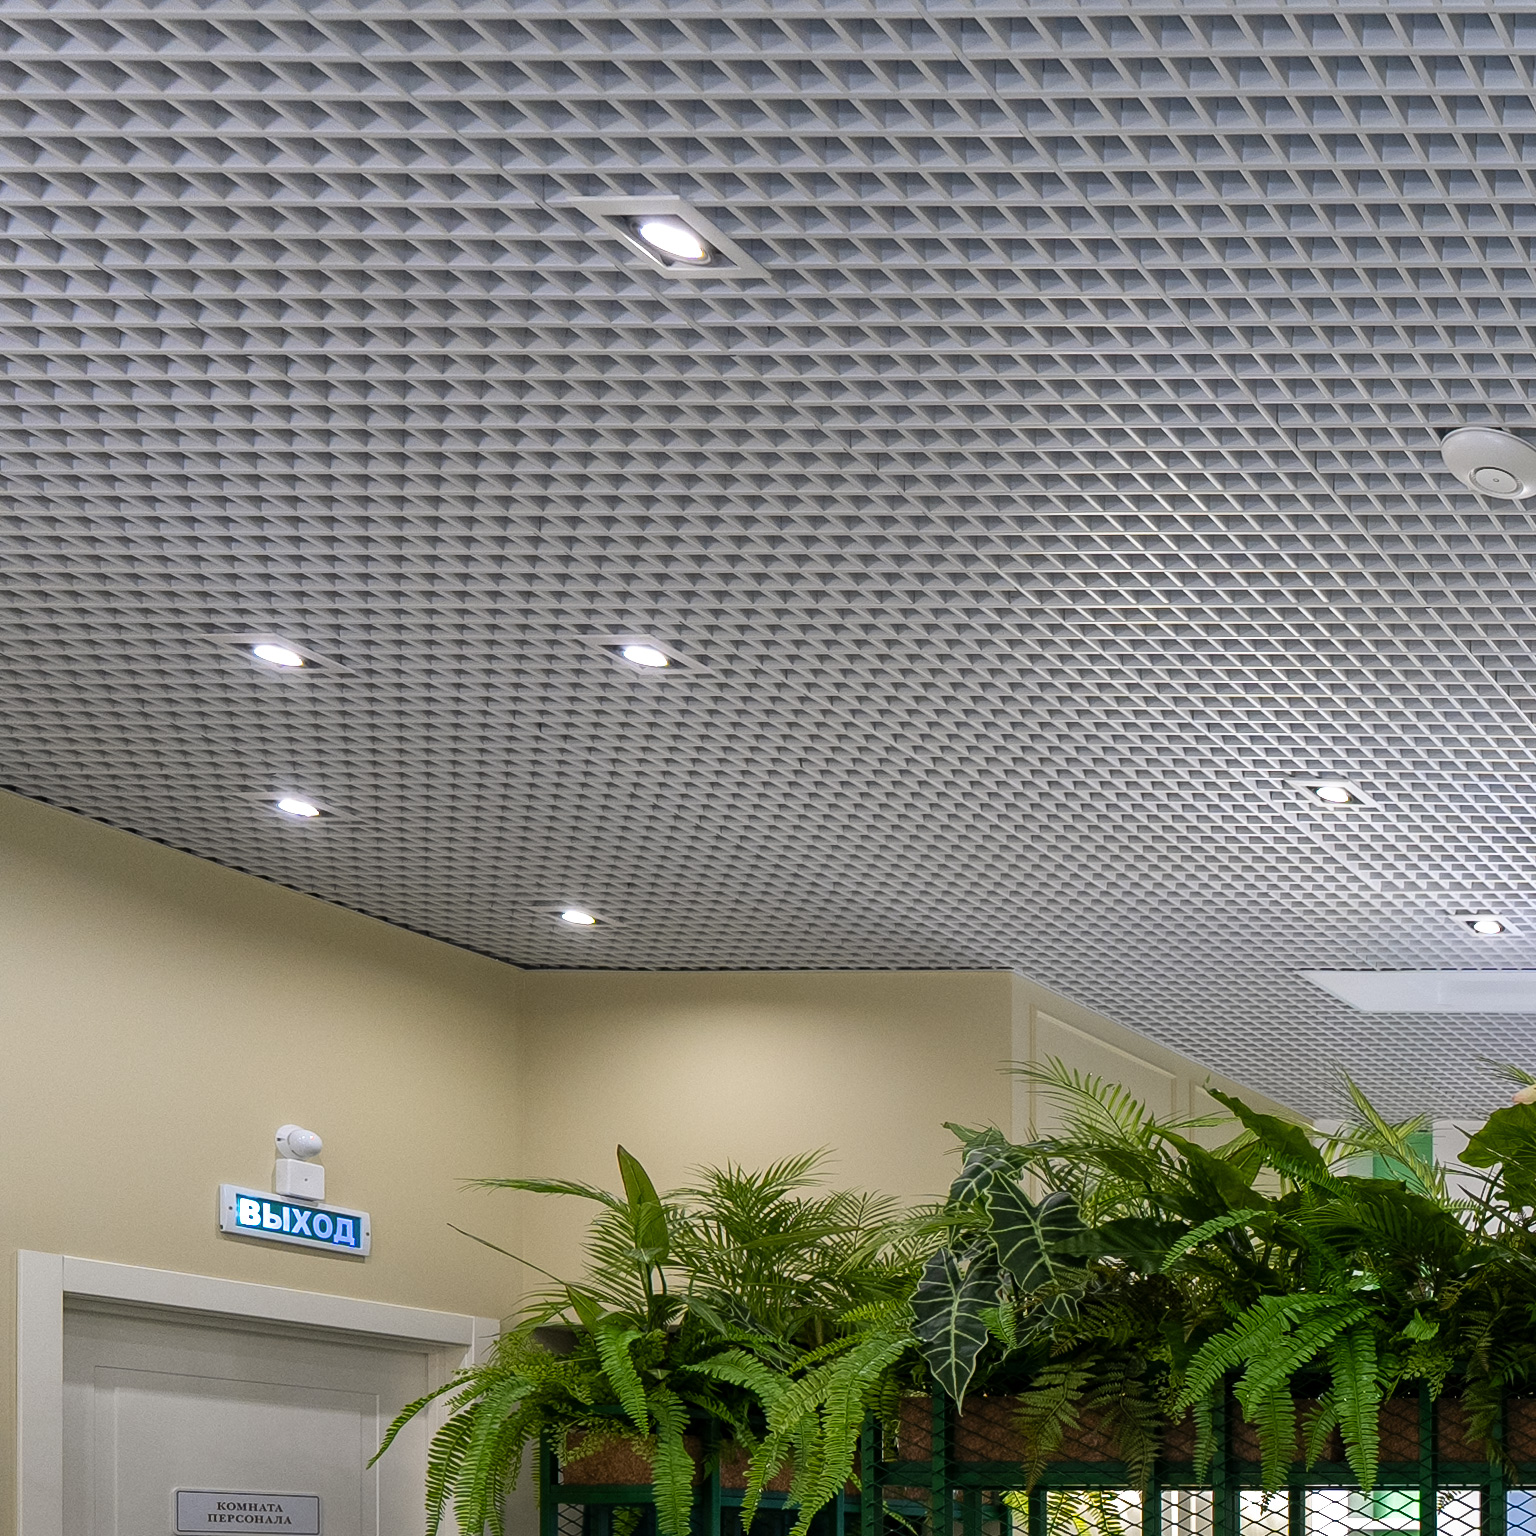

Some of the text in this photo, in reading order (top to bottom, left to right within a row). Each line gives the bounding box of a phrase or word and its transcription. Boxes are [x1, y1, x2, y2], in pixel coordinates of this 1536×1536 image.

[240, 1197, 356, 1246] ВЫХОД
[216, 1501, 283, 1513] КОМНАТА
[207, 1513, 292, 1525] ПЕРСОНАЛА
